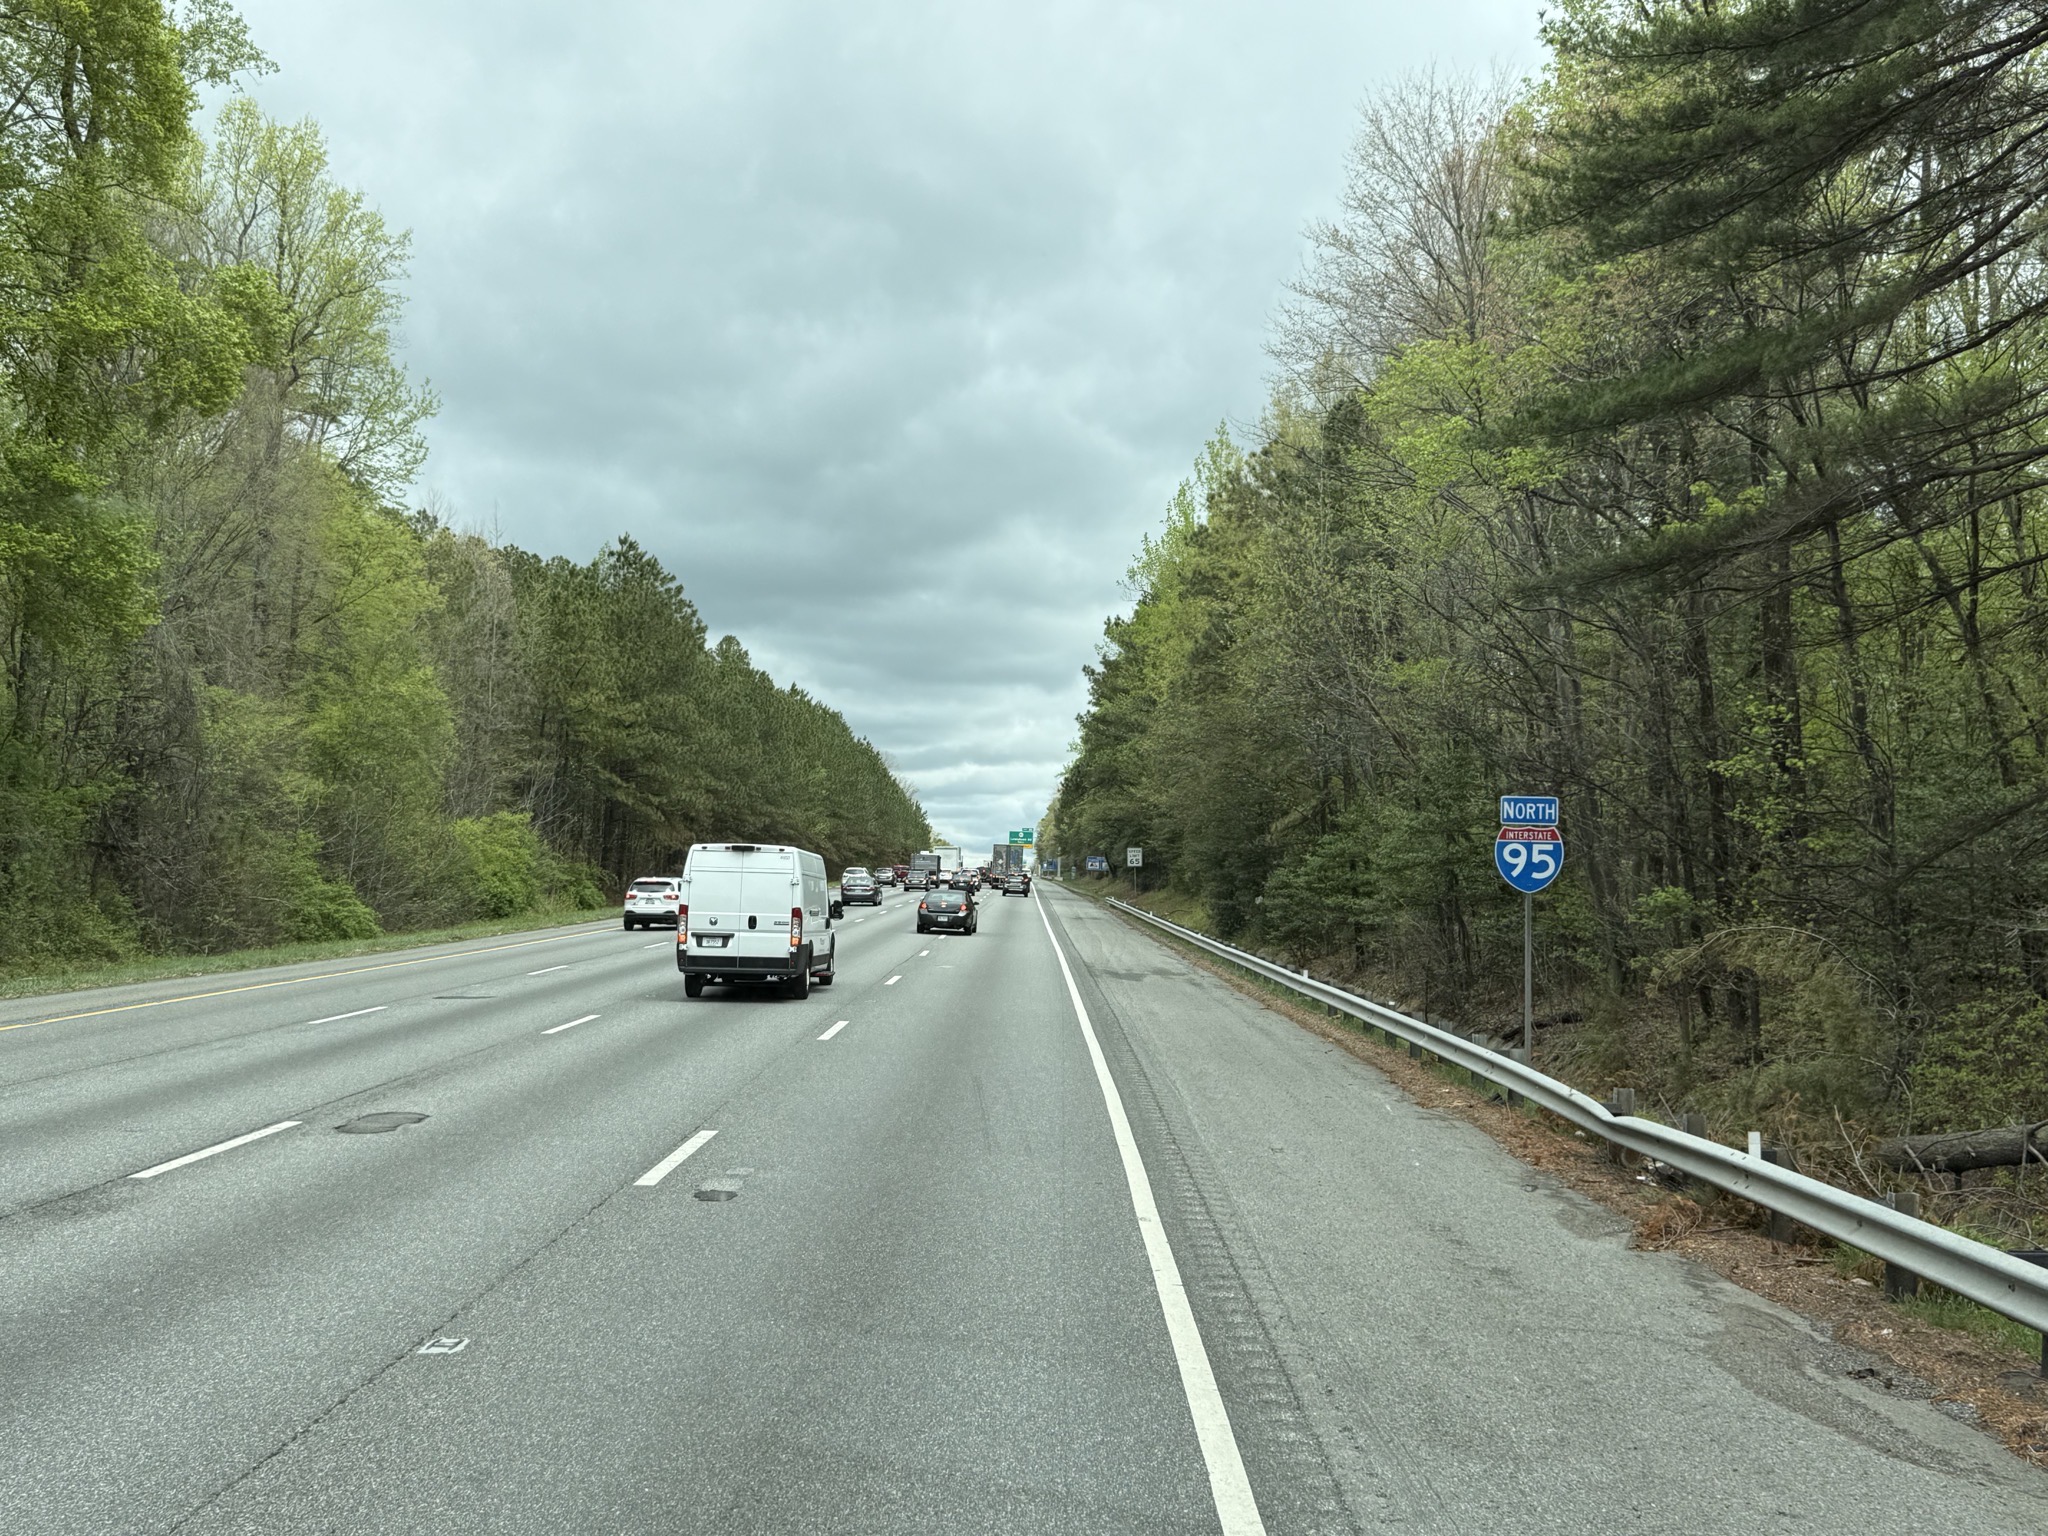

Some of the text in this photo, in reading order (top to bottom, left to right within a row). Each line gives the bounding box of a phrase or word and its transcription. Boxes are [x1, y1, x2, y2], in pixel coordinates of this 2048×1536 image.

[1503, 801, 1555, 820] NORTH
[1505, 831, 1552, 840] INTERSTATE
[1503, 843, 1556, 879] 95
